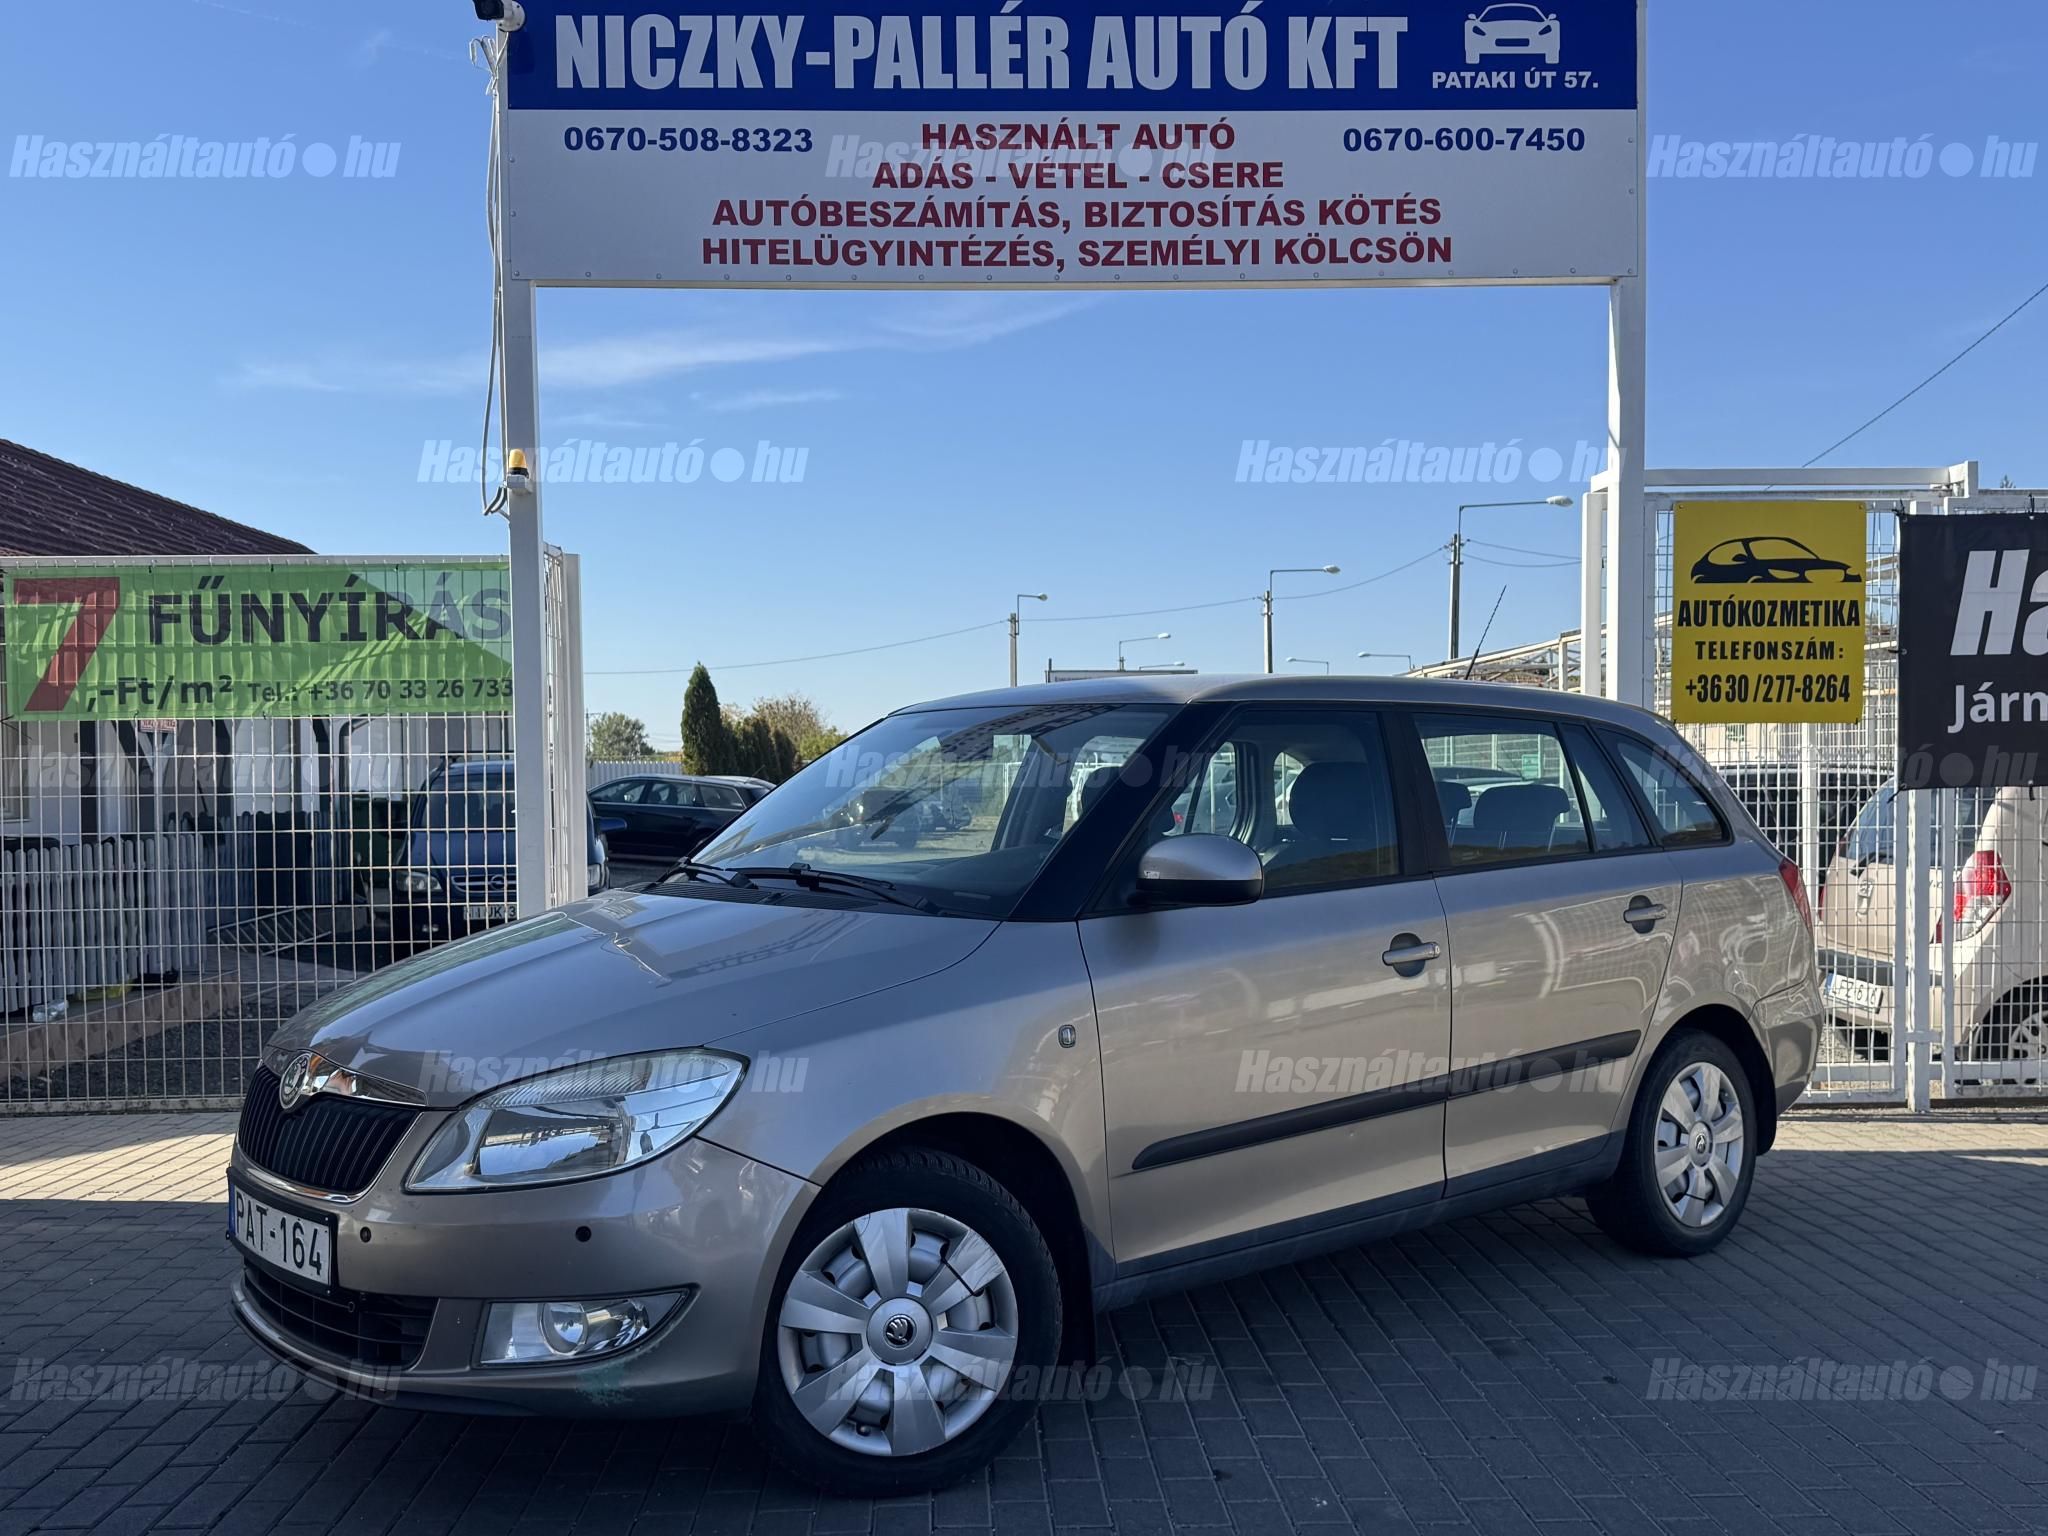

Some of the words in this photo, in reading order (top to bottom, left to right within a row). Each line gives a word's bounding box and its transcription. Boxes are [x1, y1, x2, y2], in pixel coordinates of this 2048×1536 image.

[555, 0, 1071, 90] NICZKY-PALLÉR
[1087, 1, 1268, 91] AUTÓ
[1288, 16, 1409, 90] KFT
[1432, 71, 1516, 89] PATAKI
[1524, 67, 1557, 89] ÚT
[1564, 71, 1599, 89] 57.
[563, 126, 814, 153] 0670-508-8323
[922, 116, 1121, 150] HASZNÁLT
[1132, 116, 1236, 150] AUTÓ
[1343, 126, 1586, 152] 0670-600-7450
[872, 155, 974, 189] ADÁS
[1008, 155, 1129, 189] VÉTEL
[1161, 162, 1285, 189] CSERE
[712, 193, 1071, 235] AUTÓBESZÁMÍTÁS,
[1084, 193, 1305, 228] BIZTOSÍTÁS
[1318, 192, 1442, 227] KÖTÉS
[702, 231, 1065, 274] HITELÜGYINTÉZÉS,
[1078, 232, 1261, 267] SZEMÉLYI
[1274, 232, 1453, 266] KÖLCSÖN
[148, 571, 511, 646] FŰNYÍRÁS
[1677, 594, 1861, 628] AUTÓKOZMETIKA
[14, 577, 120, 712] 7
[1695, 636, 1844, 661] TELEFONSZÁM:
[247, 683, 299, 703] Tel.:
[309, 681, 354, 702] +36
[362, 680, 391, 701] 70
[400, 680, 427, 700] 33
[436, 679, 465, 699] 26
[472, 678, 514, 699] 733
[236, 1190, 323, 1277] PAT-164
